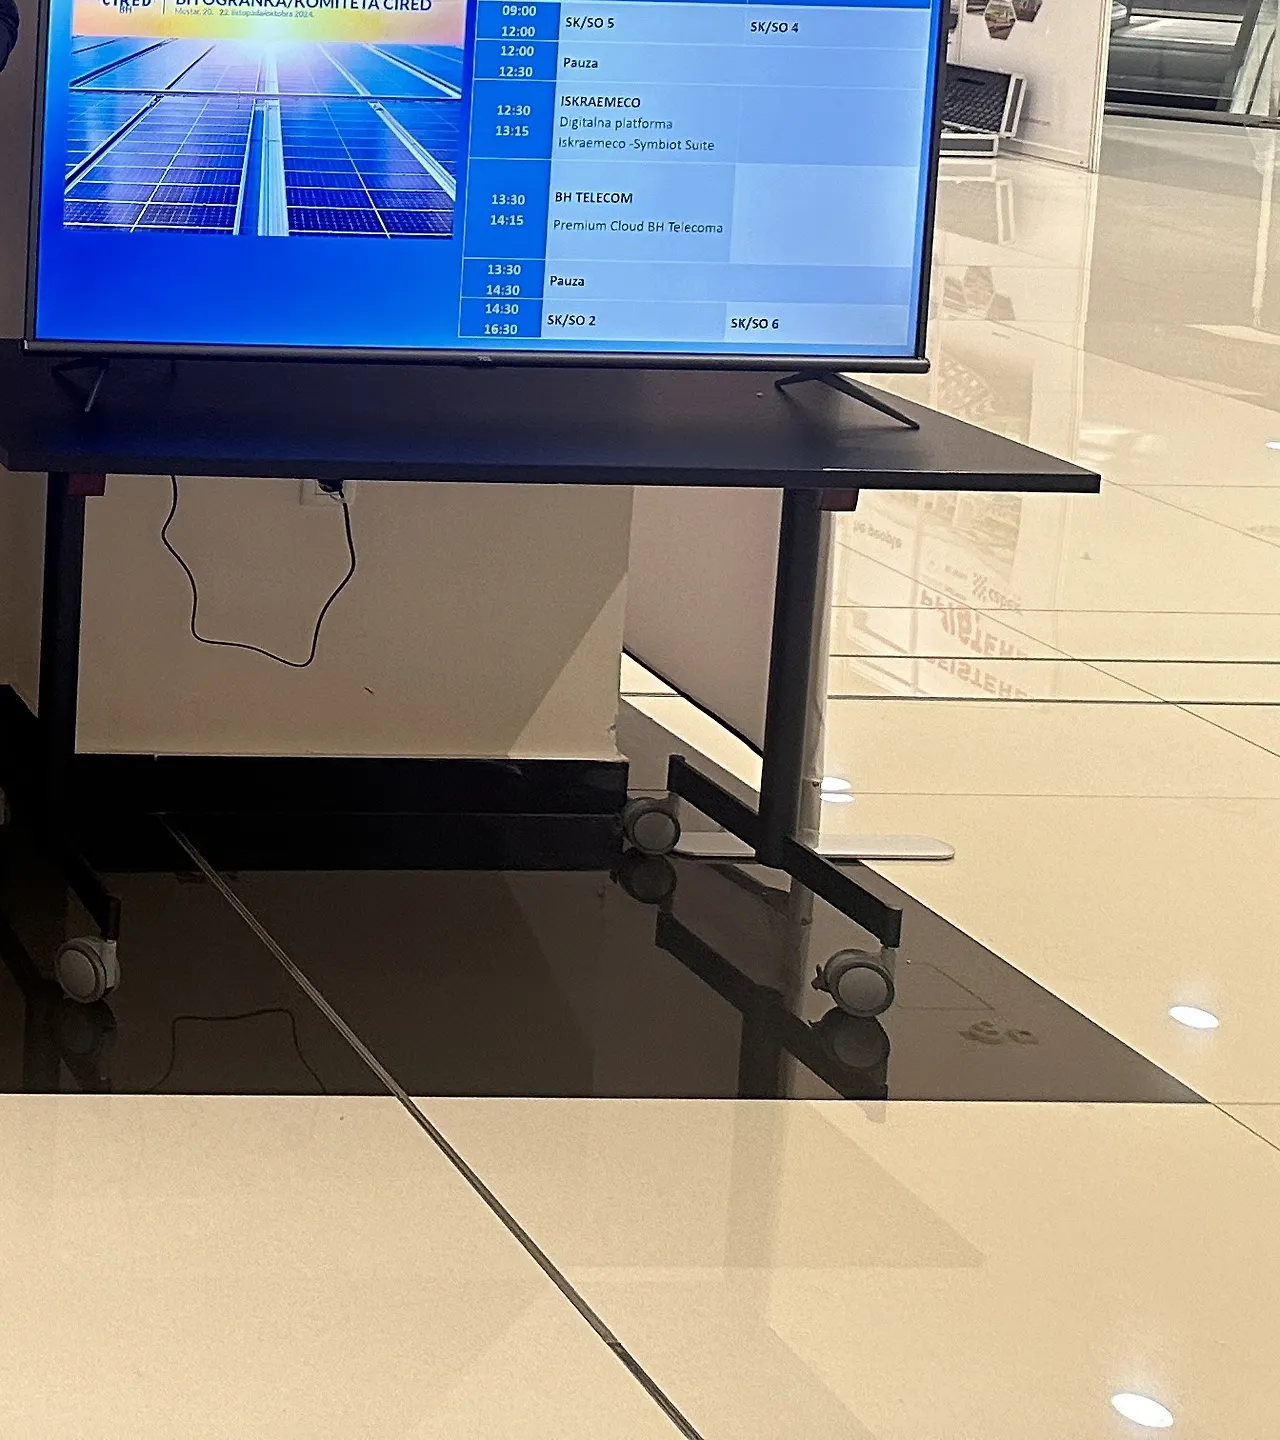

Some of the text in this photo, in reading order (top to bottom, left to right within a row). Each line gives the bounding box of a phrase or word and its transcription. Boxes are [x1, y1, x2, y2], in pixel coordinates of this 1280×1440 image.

[502, 5, 537, 17] 09:00
[565, 16, 615, 29] SK/SO 5
[750, 21, 799, 34] SK/SO 4
[501, 25, 536, 38] 12:00
[500, 45, 535, 57] 12:00
[563, 57, 599, 70] Pauza
[499, 65, 533, 78] 12:30
[560, 95, 641, 109] ISKRAEMECO
[496, 105, 531, 117] 12:30
[495, 125, 529, 137] 13:15
[560, 117, 673, 133] Digitalna platforma
[558, 137, 715, 153] Iskraemeco -Symbiot Suite
[491, 194, 525, 206] 13:30
[555, 192, 633, 204] BH TELECOM
[490, 214, 524, 226] 14:15
[554, 219, 723, 234] Premium Cloud BH Telecoma
[487, 264, 521, 276] 13:30
[550, 276, 585, 288] Pauza
[486, 284, 520, 296] 14:30
[485, 303, 519, 315] 14:30
[547, 314, 596, 328] SK/SO 2
[731, 317, 779, 331] SK/SO 6
[484, 323, 518, 336] 16:30
